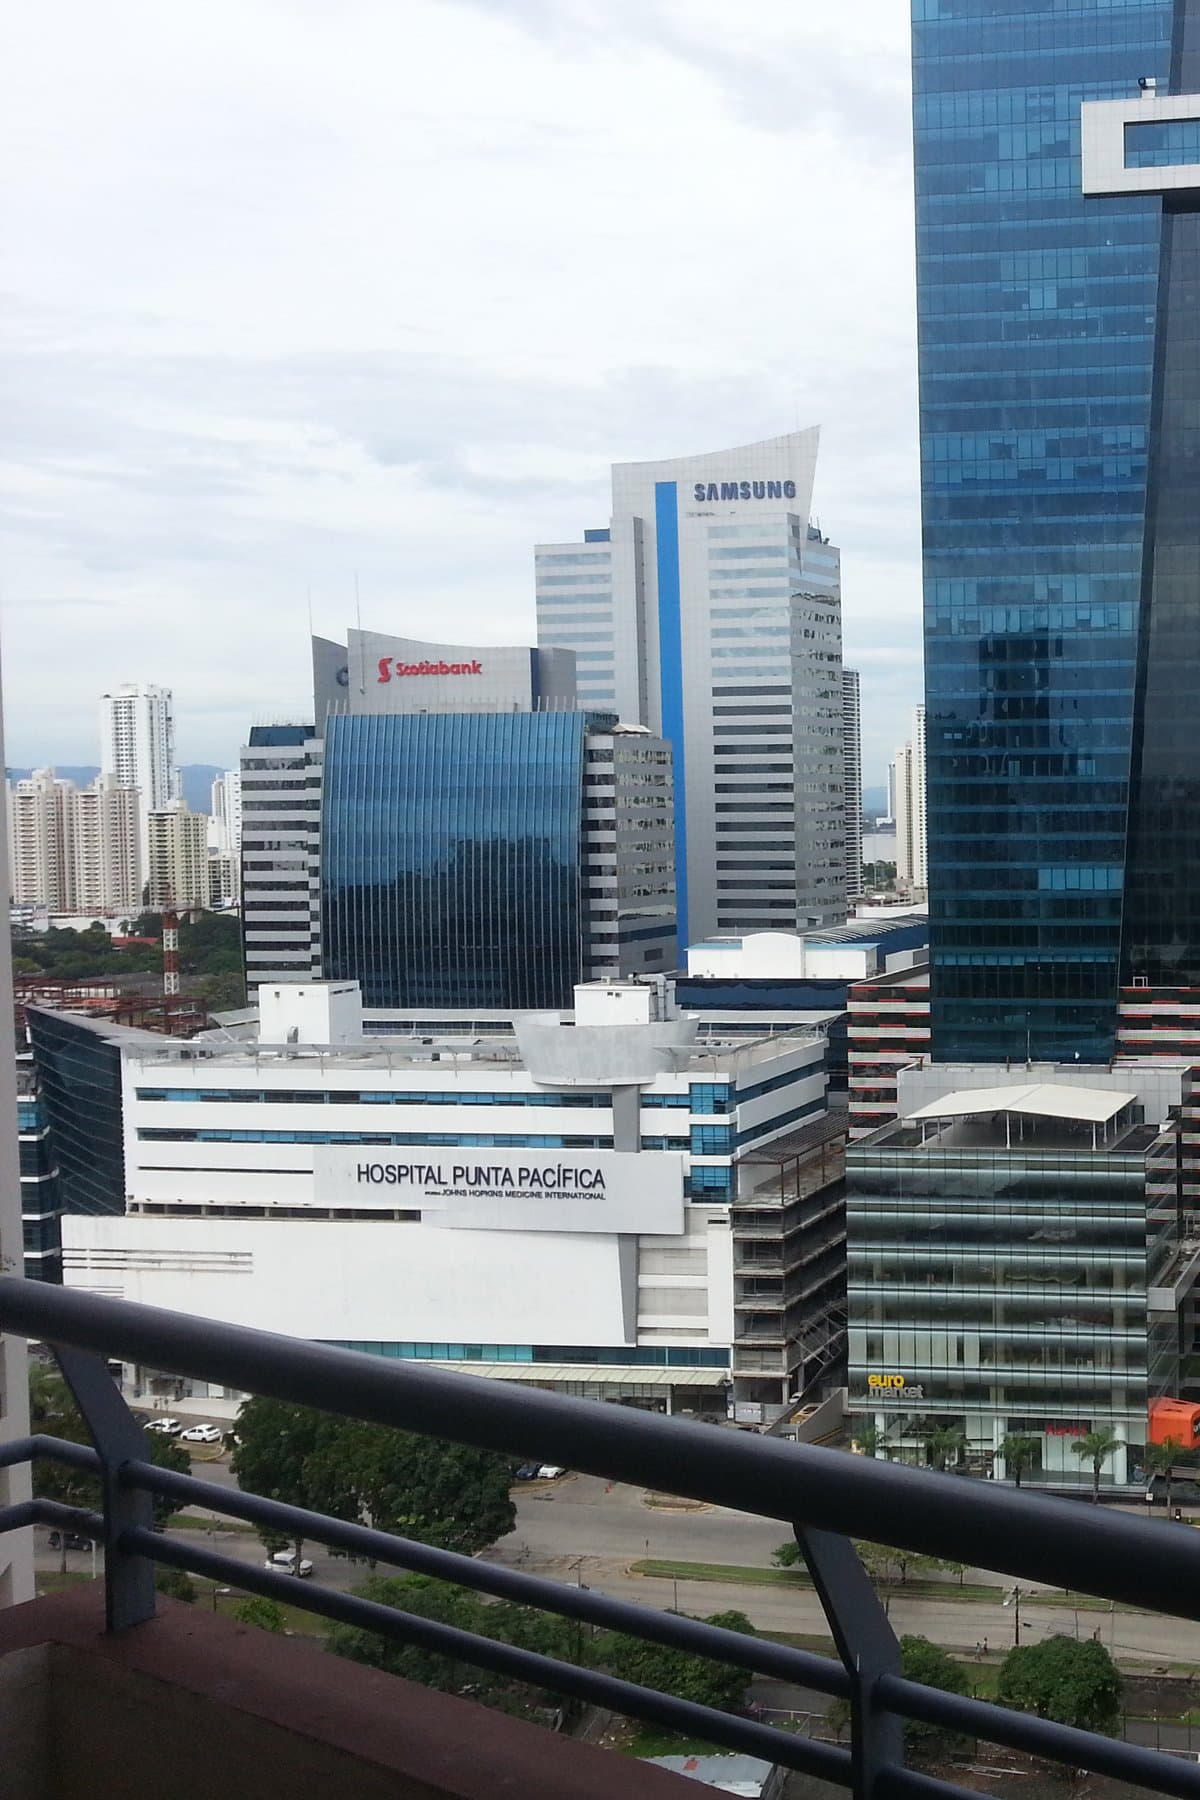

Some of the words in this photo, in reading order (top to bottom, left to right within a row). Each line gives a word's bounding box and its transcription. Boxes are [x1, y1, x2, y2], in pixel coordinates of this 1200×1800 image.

[694, 480, 796, 501] SAMSUNG
[396, 660, 482, 676] Scotiabank
[357, 1163, 447, 1185] HOSPITAL
[453, 1166, 514, 1187] PUNTA
[518, 1163, 606, 1189] PACÍFICA
[442, 1189, 467, 1197] JOHNS
[469, 1189, 503, 1198] HOPKINS
[505, 1190, 543, 1199] MEDICINE
[545, 1191, 606, 1200] INTERNATIONAL
[868, 1374, 904, 1386] euro
